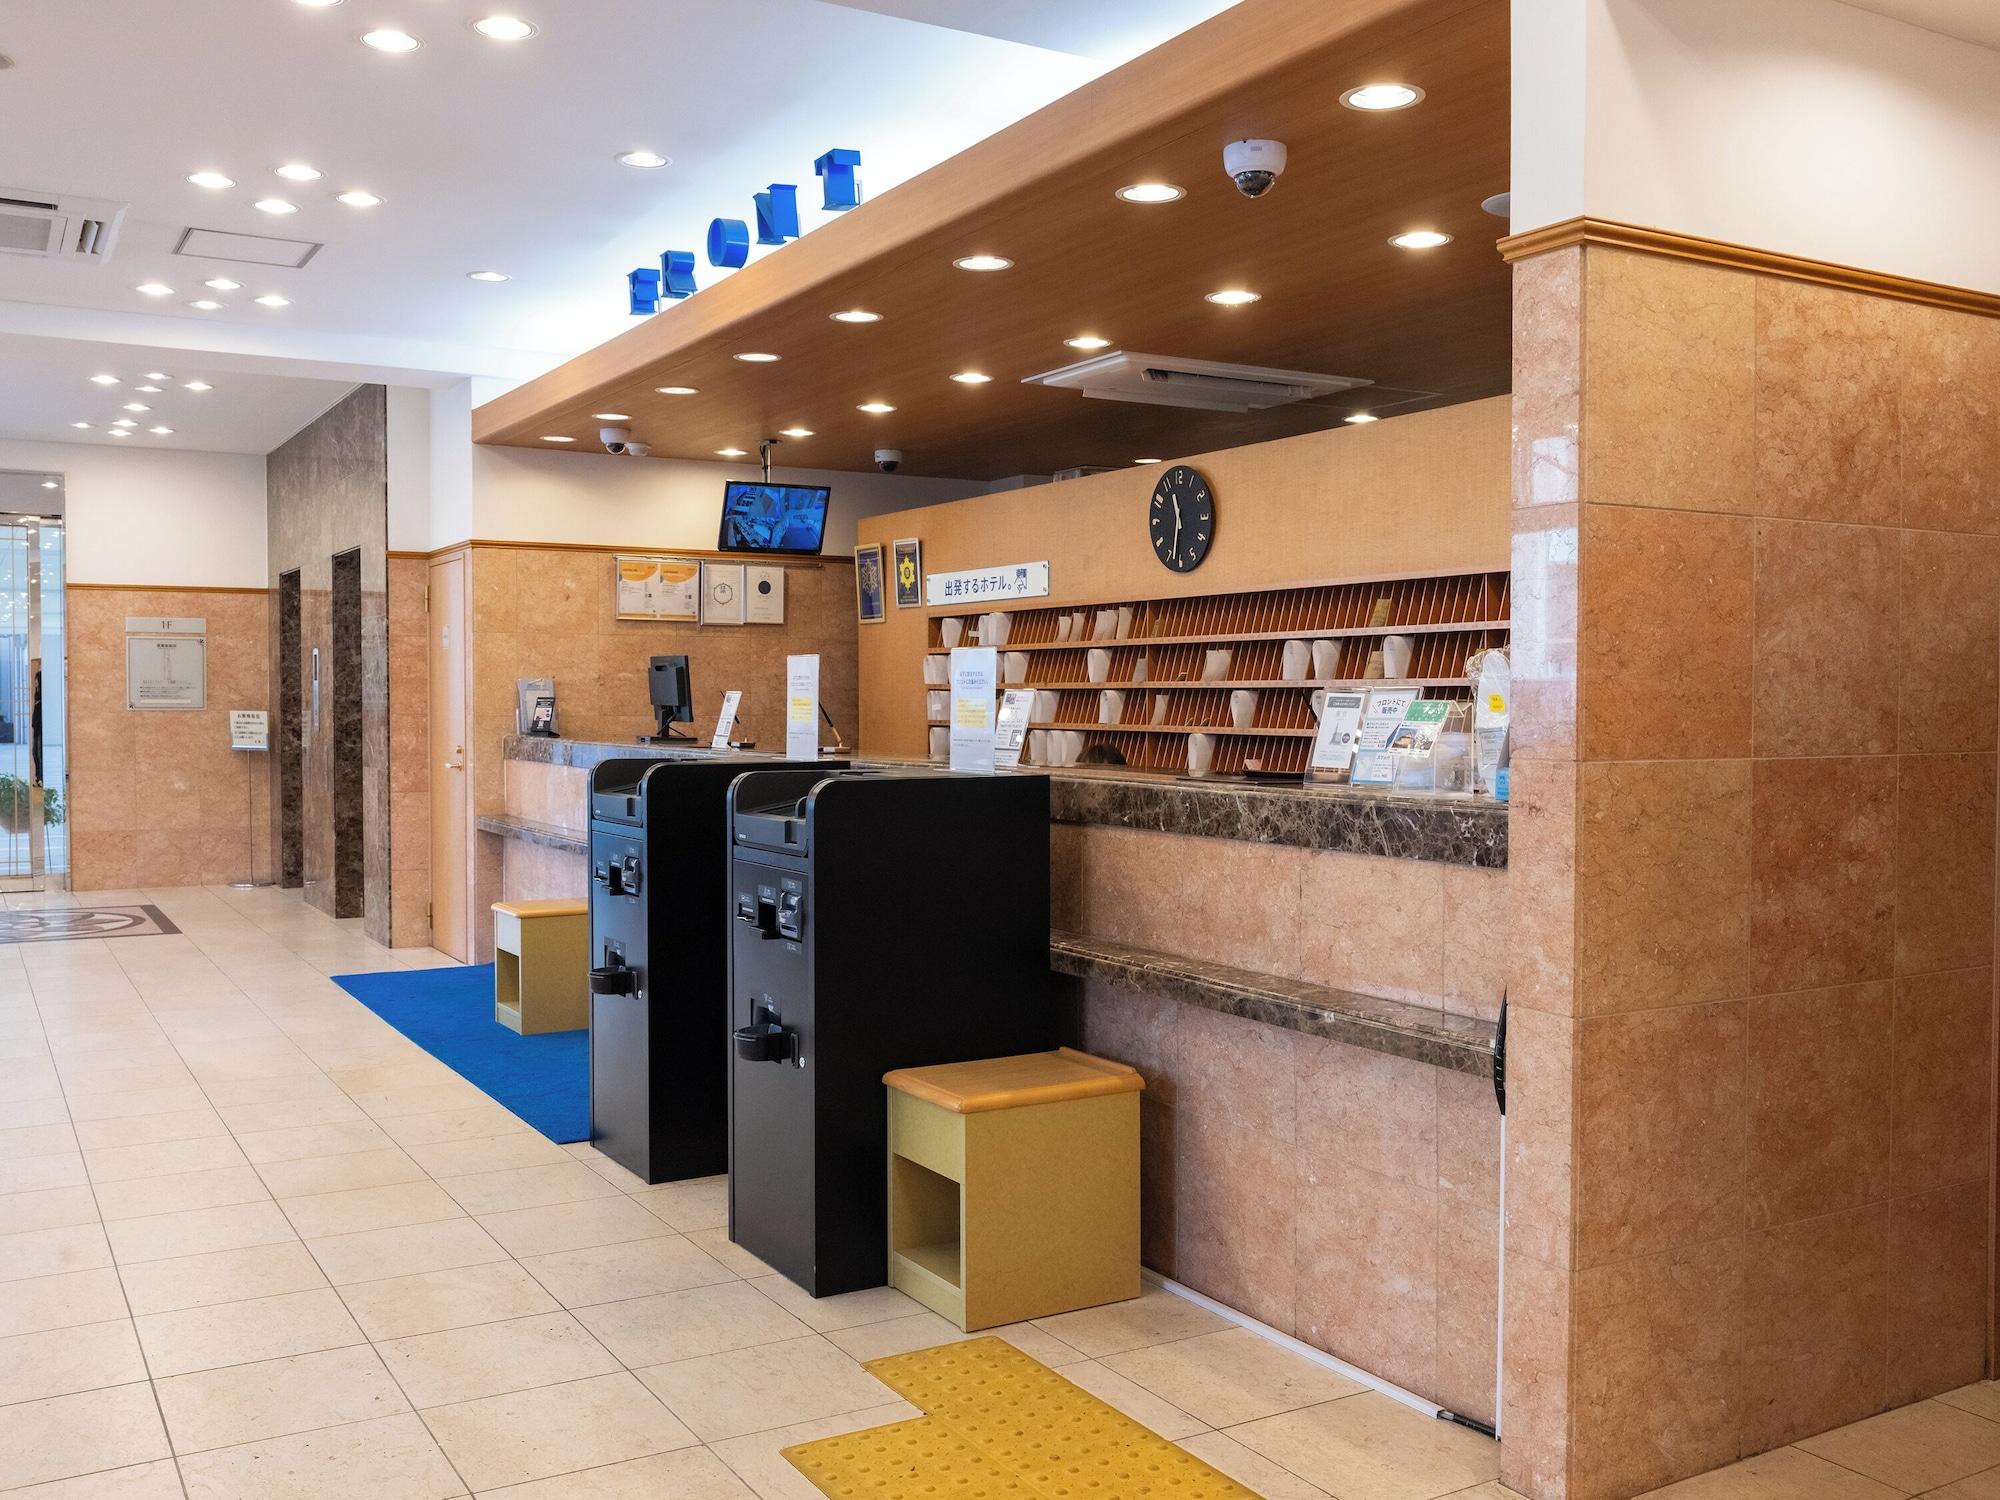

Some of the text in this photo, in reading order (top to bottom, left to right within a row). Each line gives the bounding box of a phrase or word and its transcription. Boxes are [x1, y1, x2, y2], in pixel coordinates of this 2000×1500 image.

[1175, 470, 1183, 484] 12
[1163, 477, 1172, 492] 11
[1154, 493, 1164, 508] 10
[1197, 490, 1206, 502] 2
[1200, 513, 1209, 521] 3
[1197, 532, 1206, 542] 4
[1166, 549, 1172, 562] 7
[1189, 547, 1197, 561] 5
[944, 575, 1012, 597] 出発するホテル。
[161, 620, 173, 630] 1F
